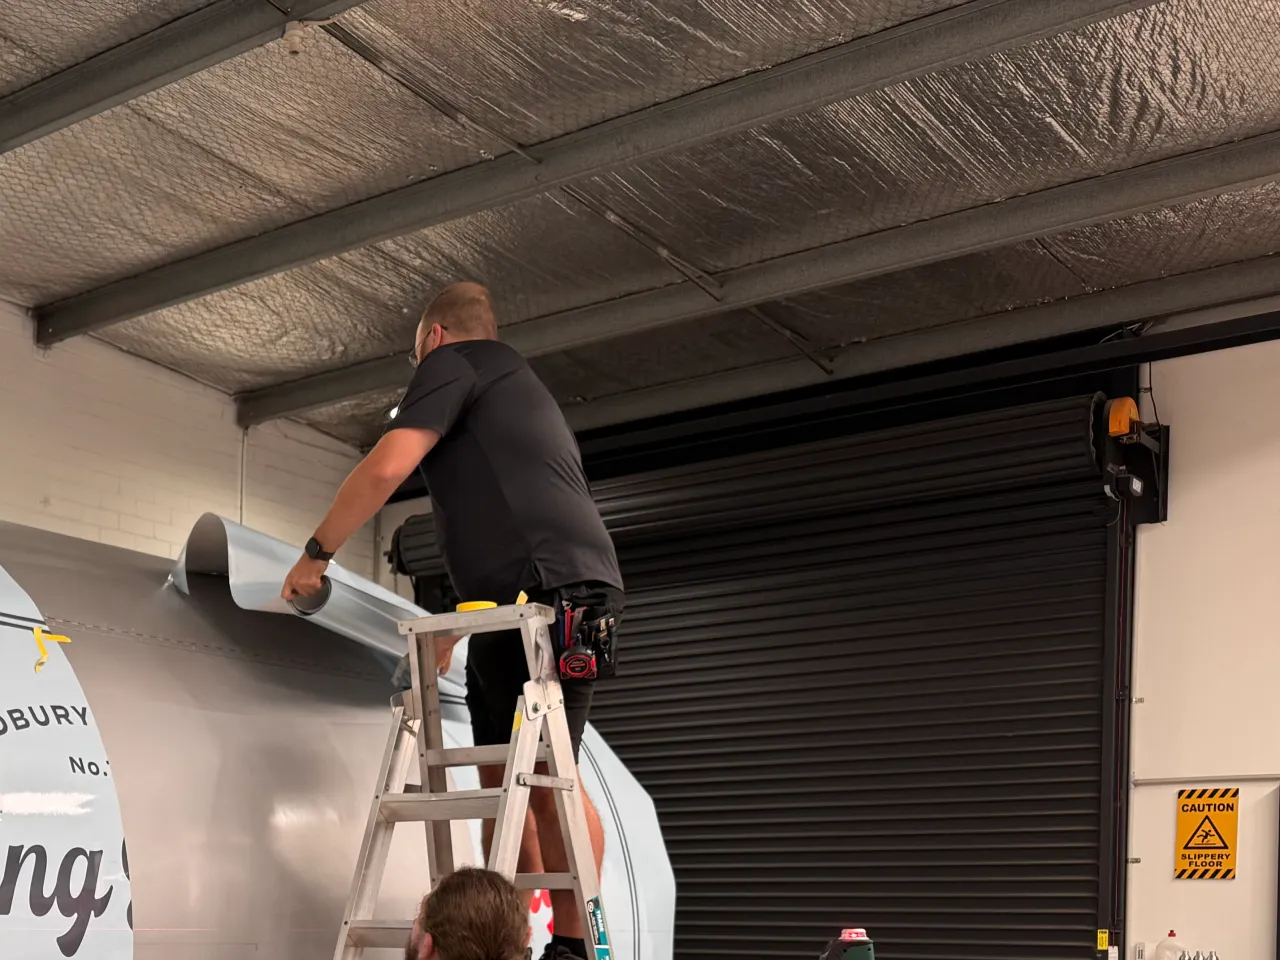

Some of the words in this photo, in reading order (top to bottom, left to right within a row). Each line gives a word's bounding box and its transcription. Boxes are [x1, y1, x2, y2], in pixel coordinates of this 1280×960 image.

[68, 756, 110, 777] No.
[1181, 803, 1235, 813] CAUTION
[1188, 860, 1223, 868] FLOOR
